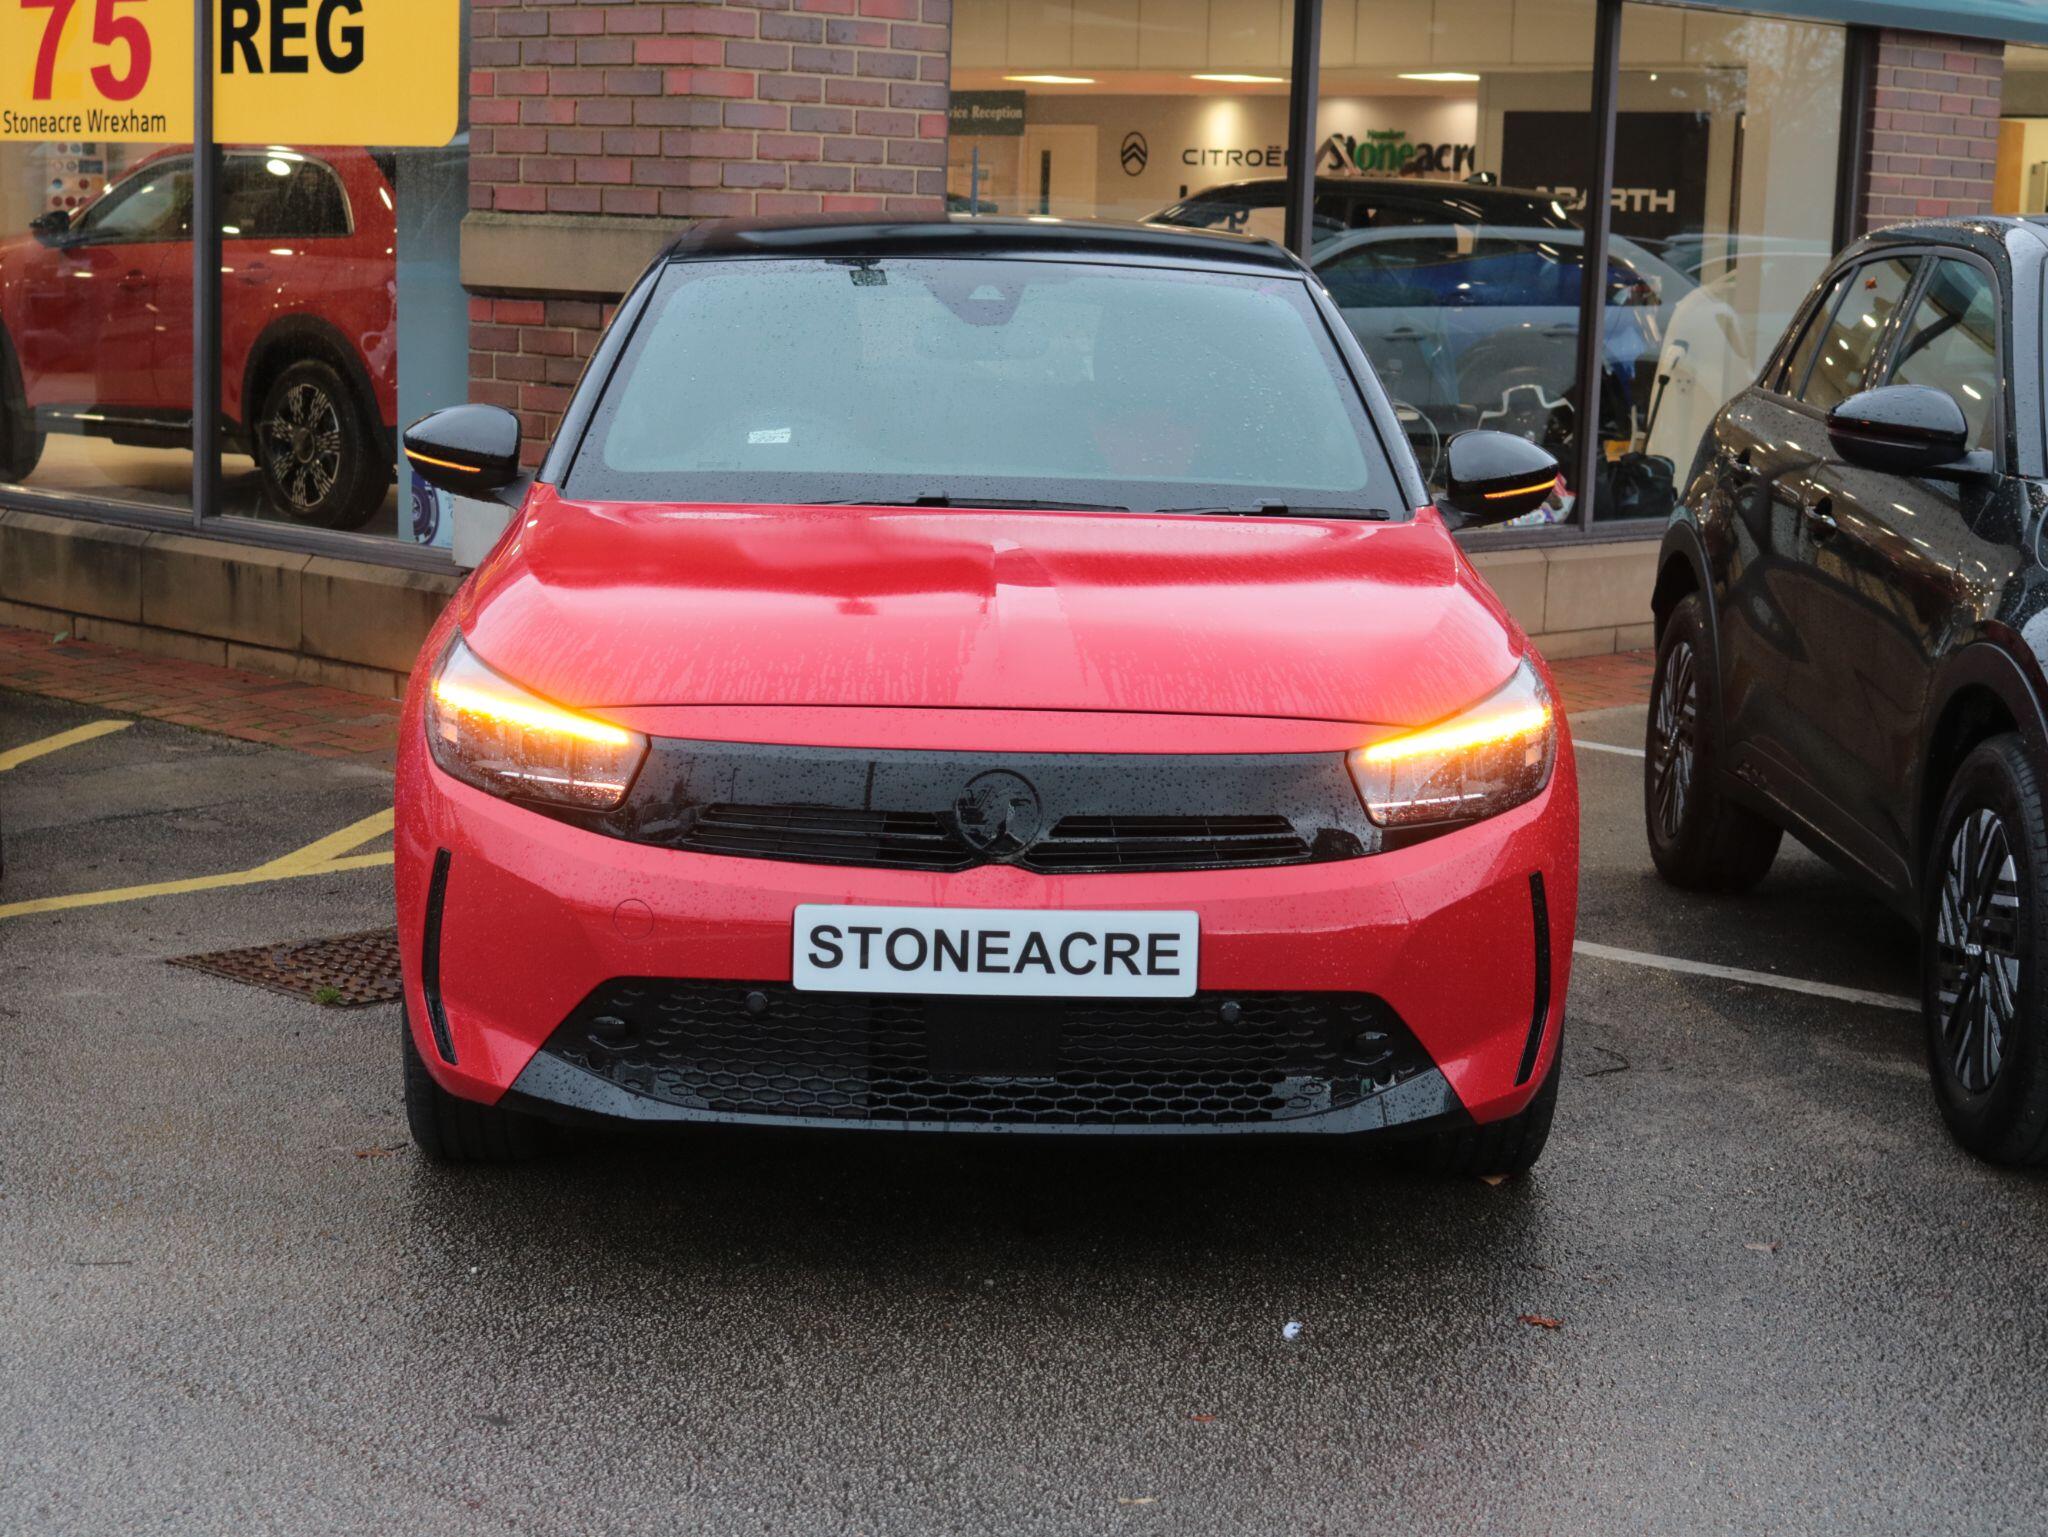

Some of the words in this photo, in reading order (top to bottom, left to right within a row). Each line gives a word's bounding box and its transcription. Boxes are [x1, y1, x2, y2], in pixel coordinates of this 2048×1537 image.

[20, 0, 152, 101] 75
[220, 0, 365, 74] REG
[3, 110, 82, 134] Stoneacre
[87, 108, 166, 133] Wrexham
[972, 105, 1023, 121] Reception
[808, 925, 1181, 976] STONEACRE
